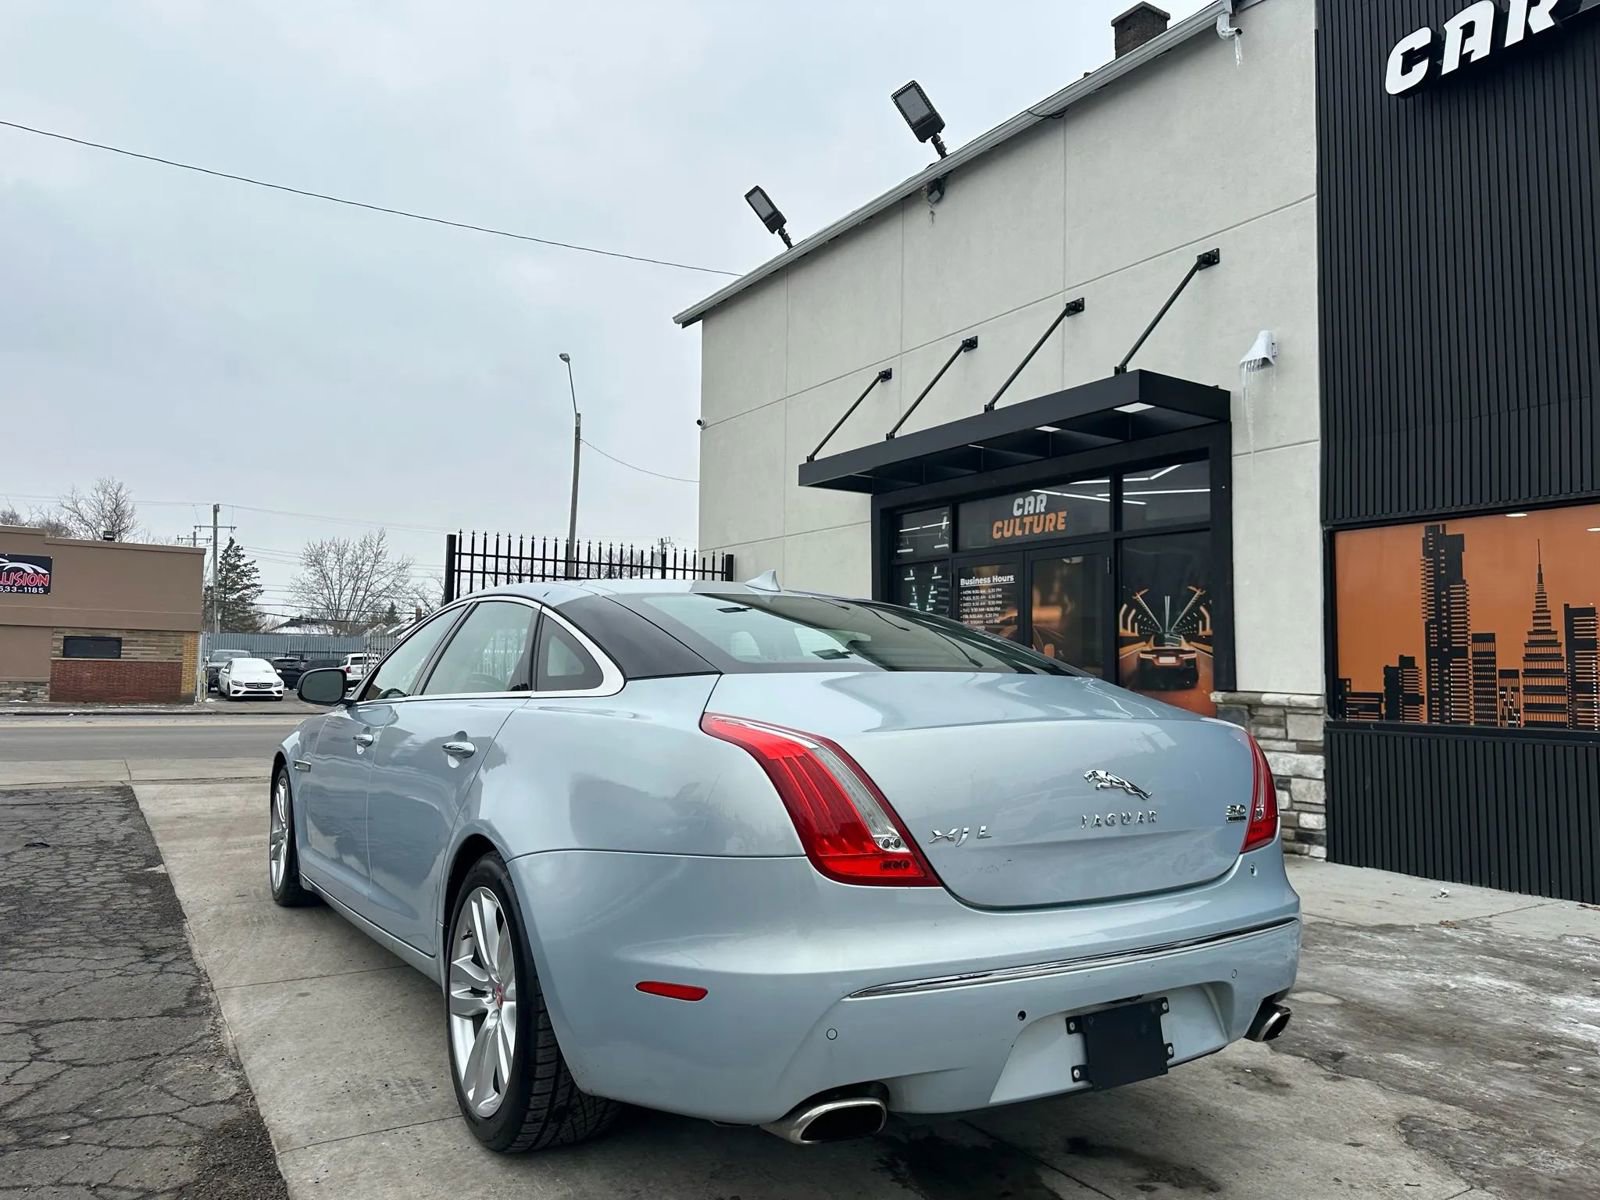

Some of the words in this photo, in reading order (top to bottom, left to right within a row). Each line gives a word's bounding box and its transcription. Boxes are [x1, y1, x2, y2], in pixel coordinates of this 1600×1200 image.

[1385, 0, 1556, 95] CAR
[1013, 494, 1047, 516] CAR
[992, 511, 1067, 539] CULTURE
[0, 571, 50, 586] LISION
[960, 576, 991, 586] Business
[992, 574, 1015, 583] Hours
[1081, 810, 1157, 829] JAGUAR
